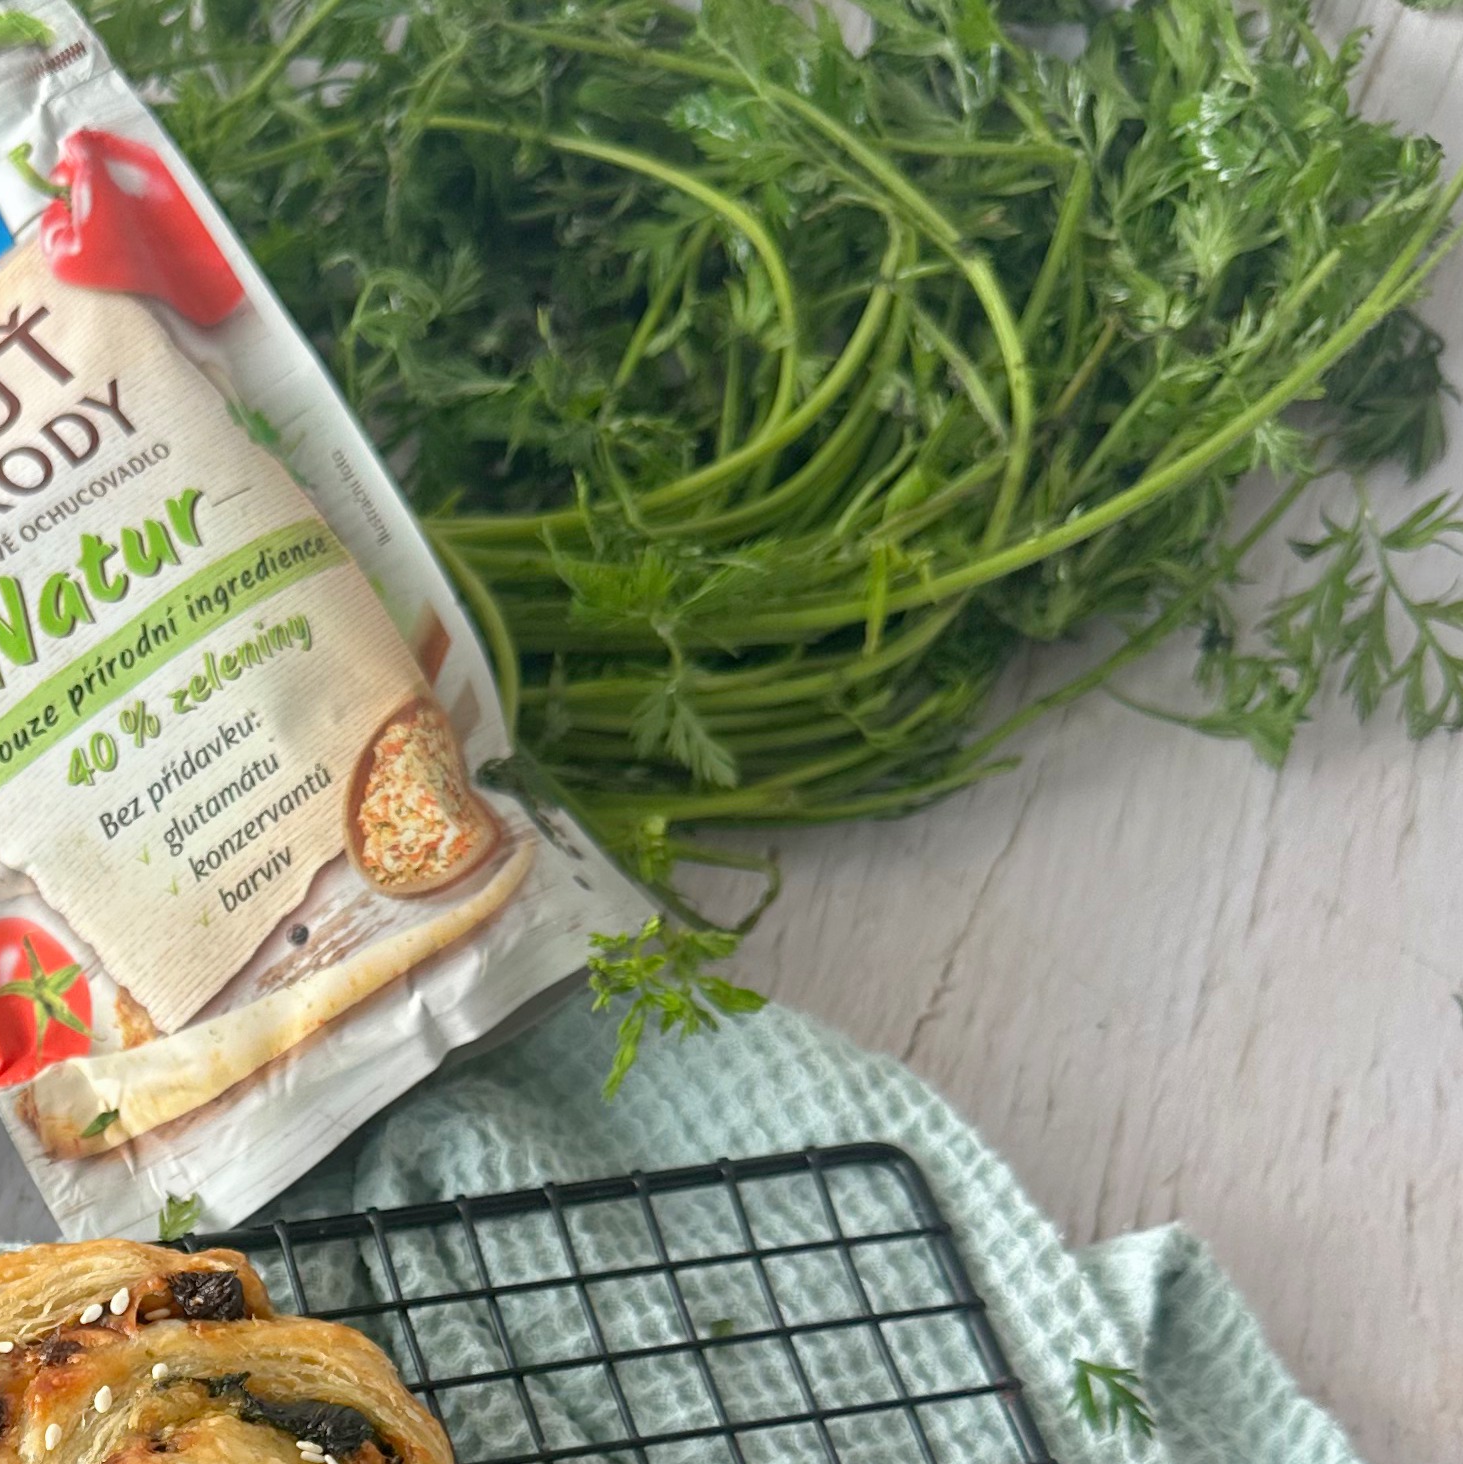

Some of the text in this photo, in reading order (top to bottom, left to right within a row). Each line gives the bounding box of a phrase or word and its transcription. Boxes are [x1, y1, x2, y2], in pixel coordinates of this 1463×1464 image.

[19, 442, 171, 543] OCHUCOVADLO
[67, 606, 179, 716] přírodní
[186, 536, 330, 624] ingredience
[67, 615, 313, 787] 40 % zeleniny
[98, 710, 263, 841] Bez přídavku:
[163, 751, 281, 858] glutamátu
[188, 762, 333, 883] konzervantů
[218, 845, 294, 914] barviv
